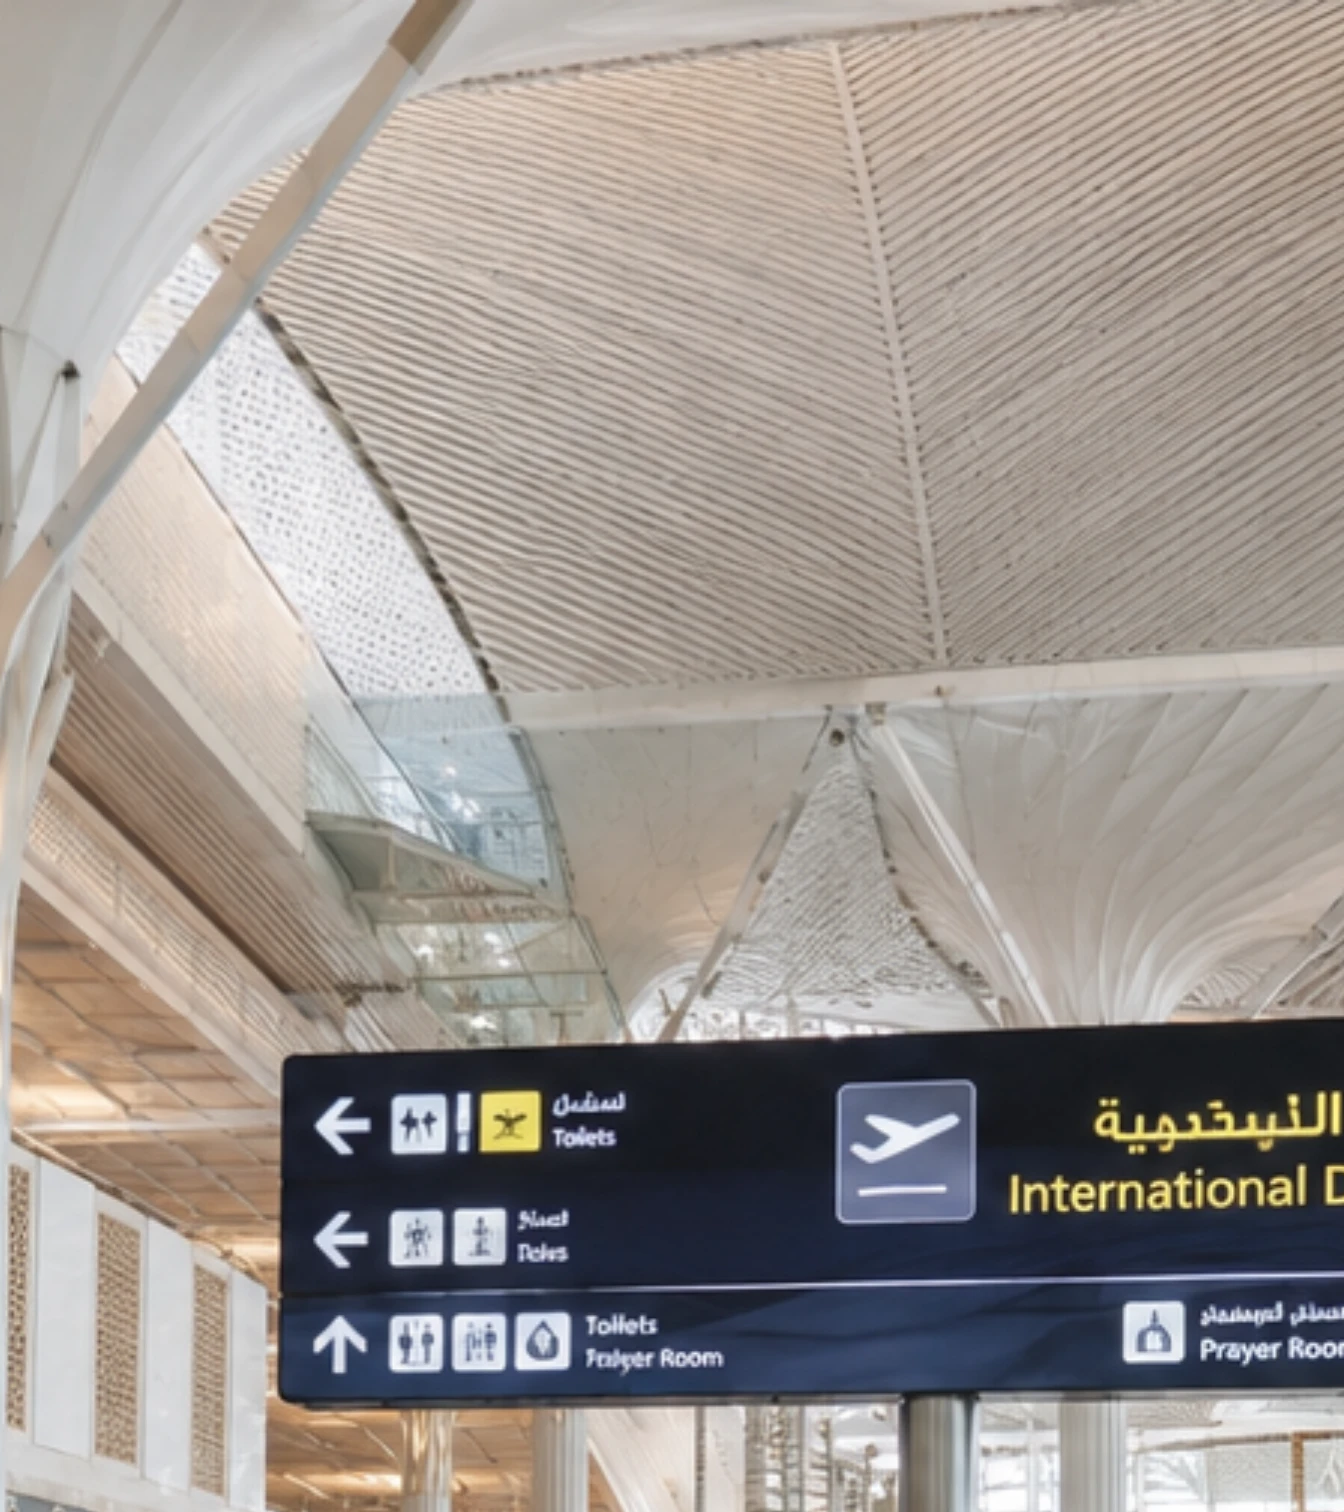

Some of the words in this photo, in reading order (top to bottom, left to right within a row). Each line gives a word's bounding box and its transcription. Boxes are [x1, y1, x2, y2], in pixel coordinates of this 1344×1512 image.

[1010, 1164, 1307, 1214] International
[660, 1347, 724, 1368] Room
[1200, 1336, 1283, 1367] Prayer
